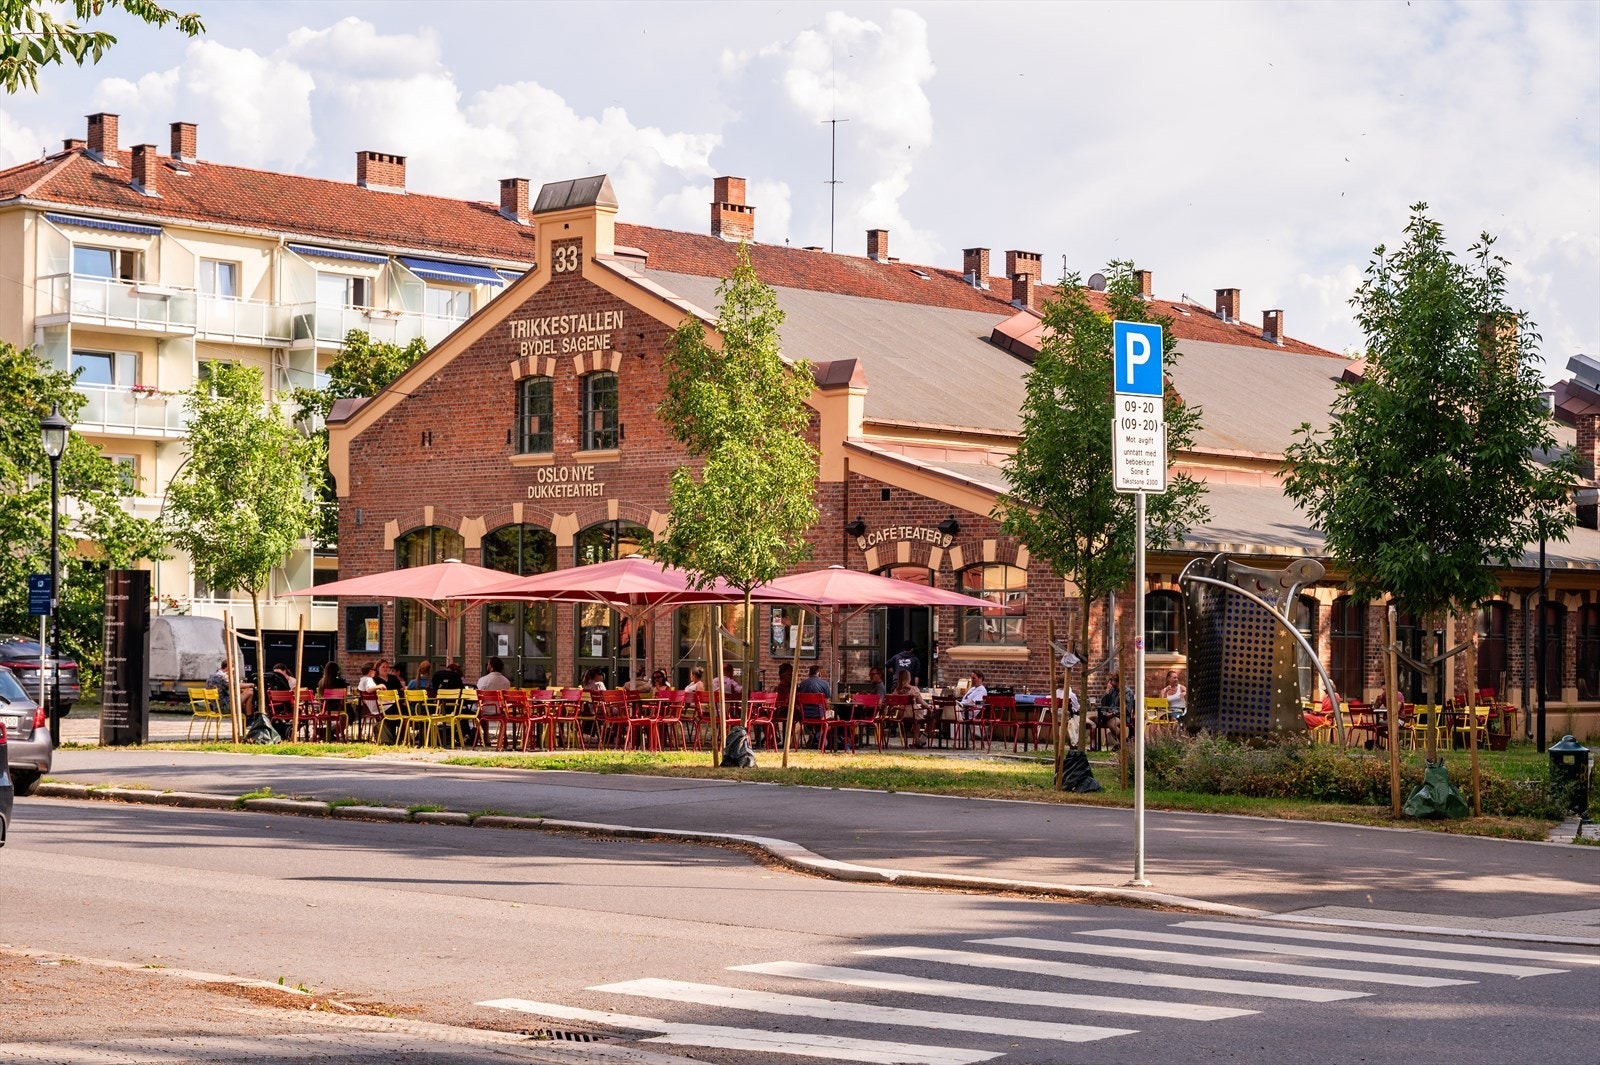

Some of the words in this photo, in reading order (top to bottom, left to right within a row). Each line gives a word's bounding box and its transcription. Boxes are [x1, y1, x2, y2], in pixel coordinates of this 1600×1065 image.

[555, 246, 578, 272] 33
[509, 310, 624, 339] TRIKKESTALLEN
[520, 340, 557, 357] BYDEL
[562, 334, 611, 353] SAGENE
[1126, 332, 1151, 384] P
[1126, 435, 1136, 443] Mot
[1138, 437, 1154, 446] avgift
[1126, 458, 1155, 466] beboerkort
[1130, 467, 1144, 475] Sone
[537, 466, 569, 484] OSLO
[572, 465, 595, 482] NYE
[528, 483, 605, 499] DUKKETEATRET
[867, 524, 898, 546] CAFÉ
[899, 526, 943, 545] TEATER
